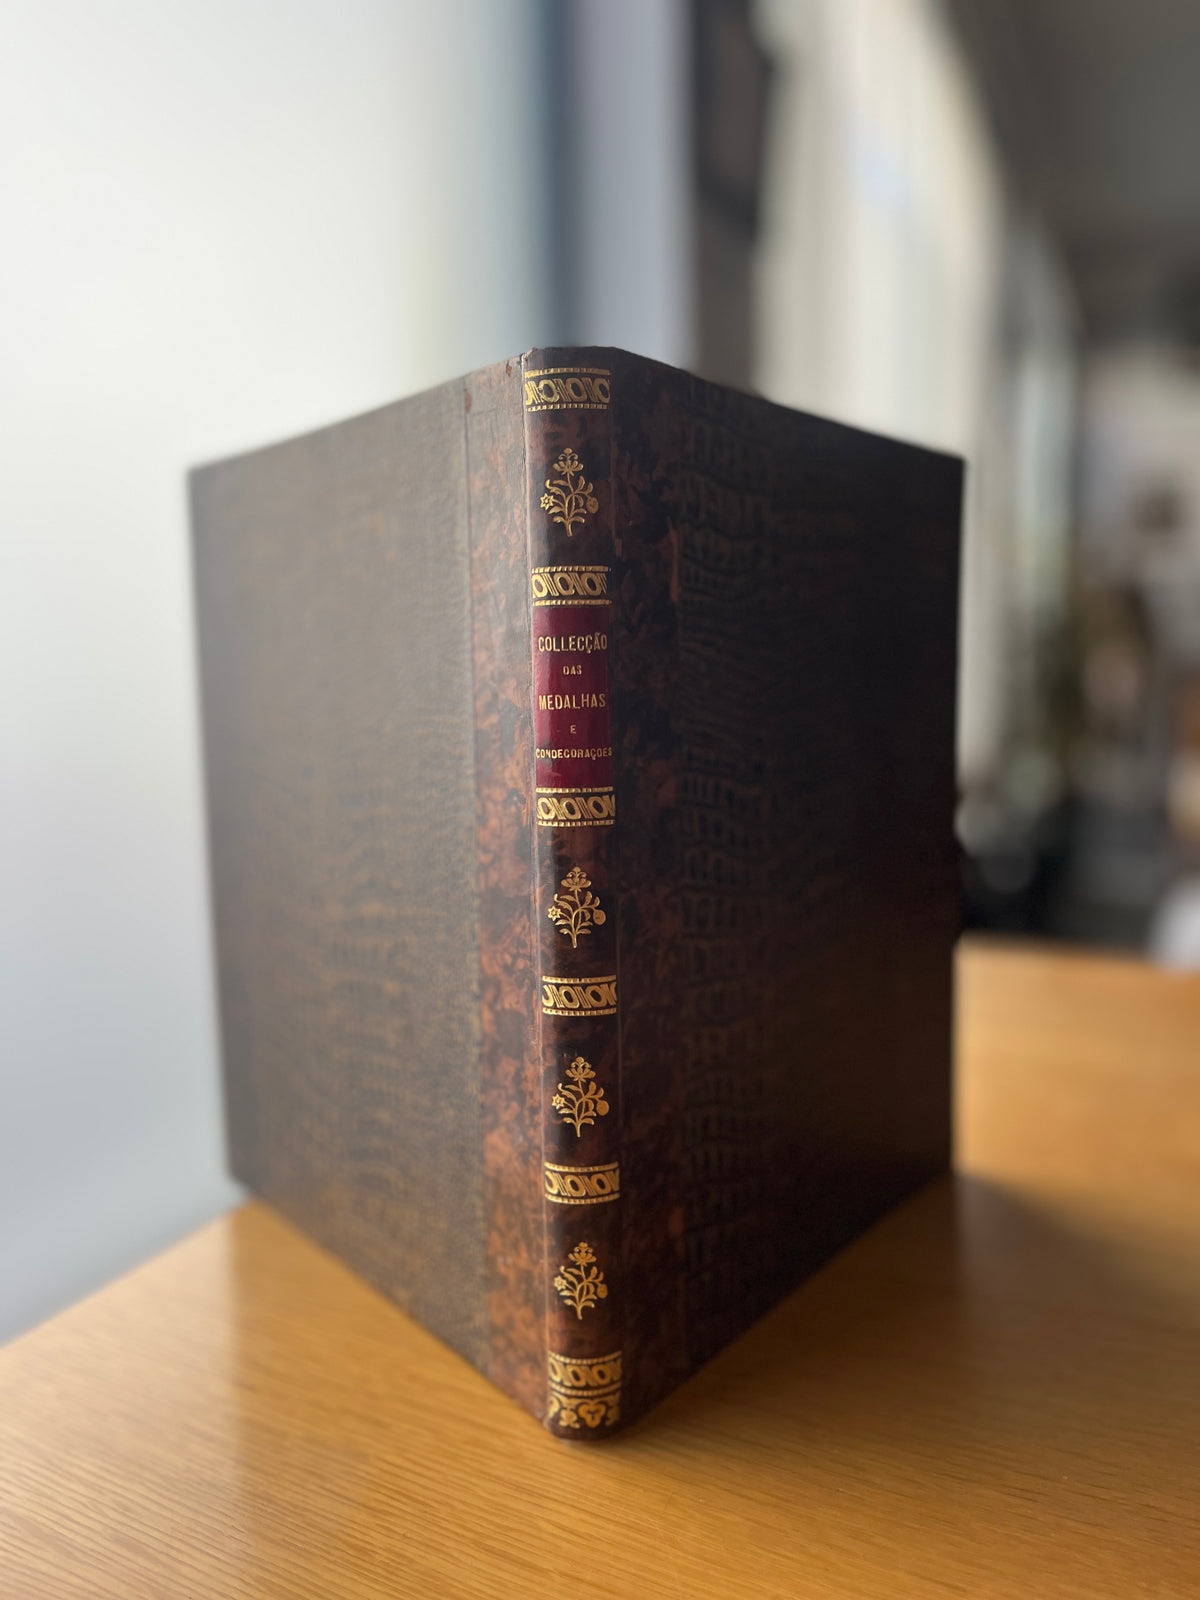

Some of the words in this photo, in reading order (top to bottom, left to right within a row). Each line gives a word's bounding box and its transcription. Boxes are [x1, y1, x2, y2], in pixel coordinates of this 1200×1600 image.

[538, 632, 608, 654] COLLECÇÃO
[563, 664, 582, 675] DAS
[538, 693, 606, 710] MEDALHAS
[570, 724, 577, 734] E
